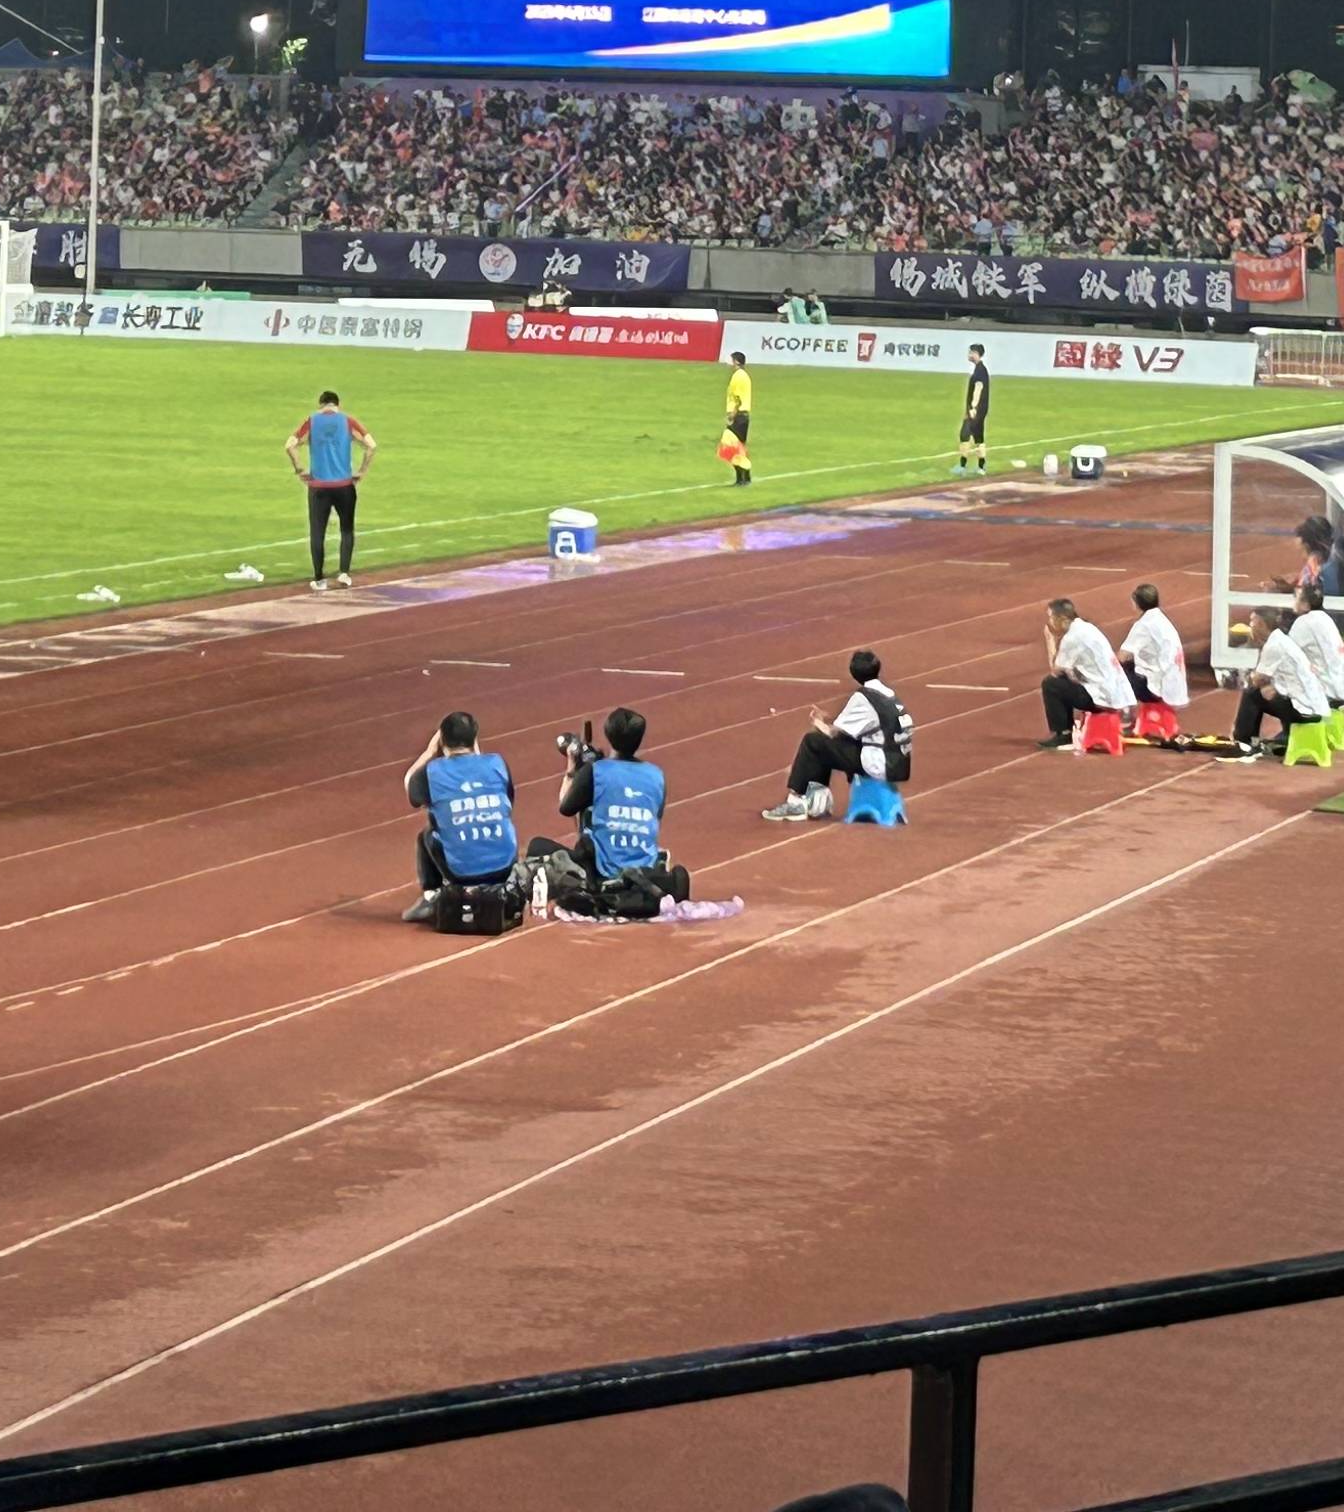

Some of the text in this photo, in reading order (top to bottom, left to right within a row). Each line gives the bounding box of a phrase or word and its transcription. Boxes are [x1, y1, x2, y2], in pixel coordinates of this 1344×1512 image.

[543, 247, 651, 283] 加油
[523, 323, 566, 340] KFC
[1133, 344, 1185, 373] V3
